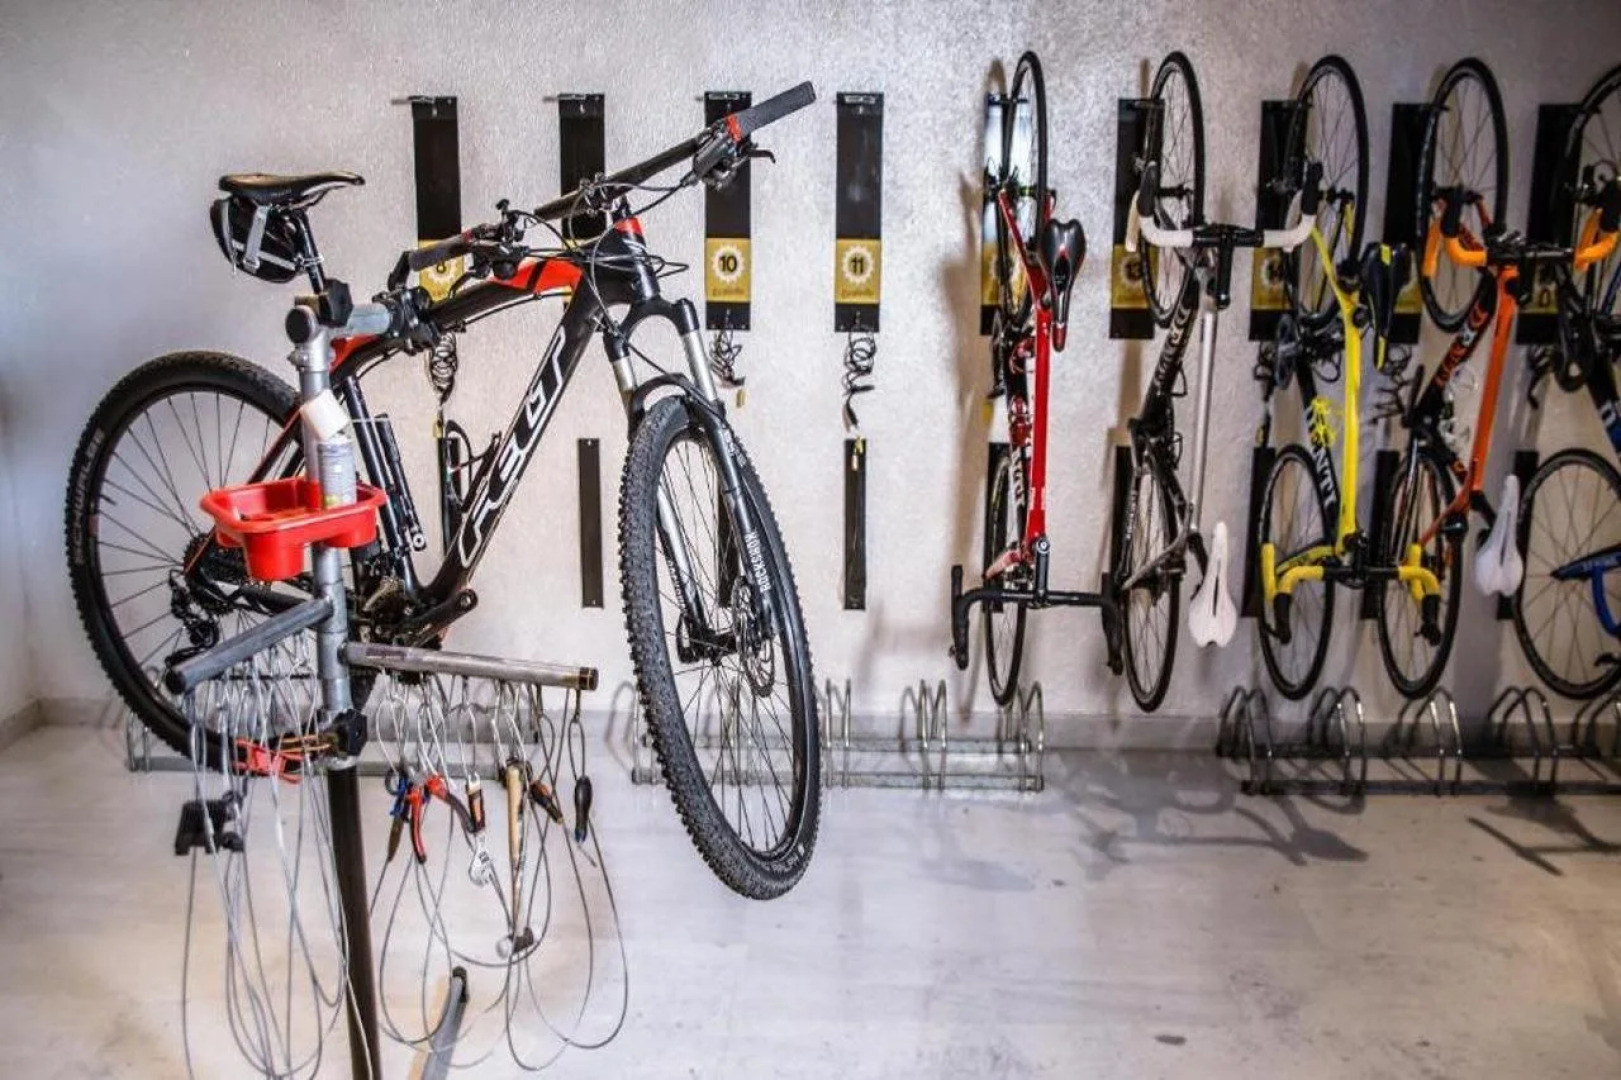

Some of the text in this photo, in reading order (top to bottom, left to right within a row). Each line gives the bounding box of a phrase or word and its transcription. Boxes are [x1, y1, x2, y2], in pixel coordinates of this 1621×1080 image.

[718, 255, 738, 272] 10
[850, 256, 865, 275] 11
[459, 324, 567, 569] FELT
[744, 530, 772, 593] ROCKSHOX
